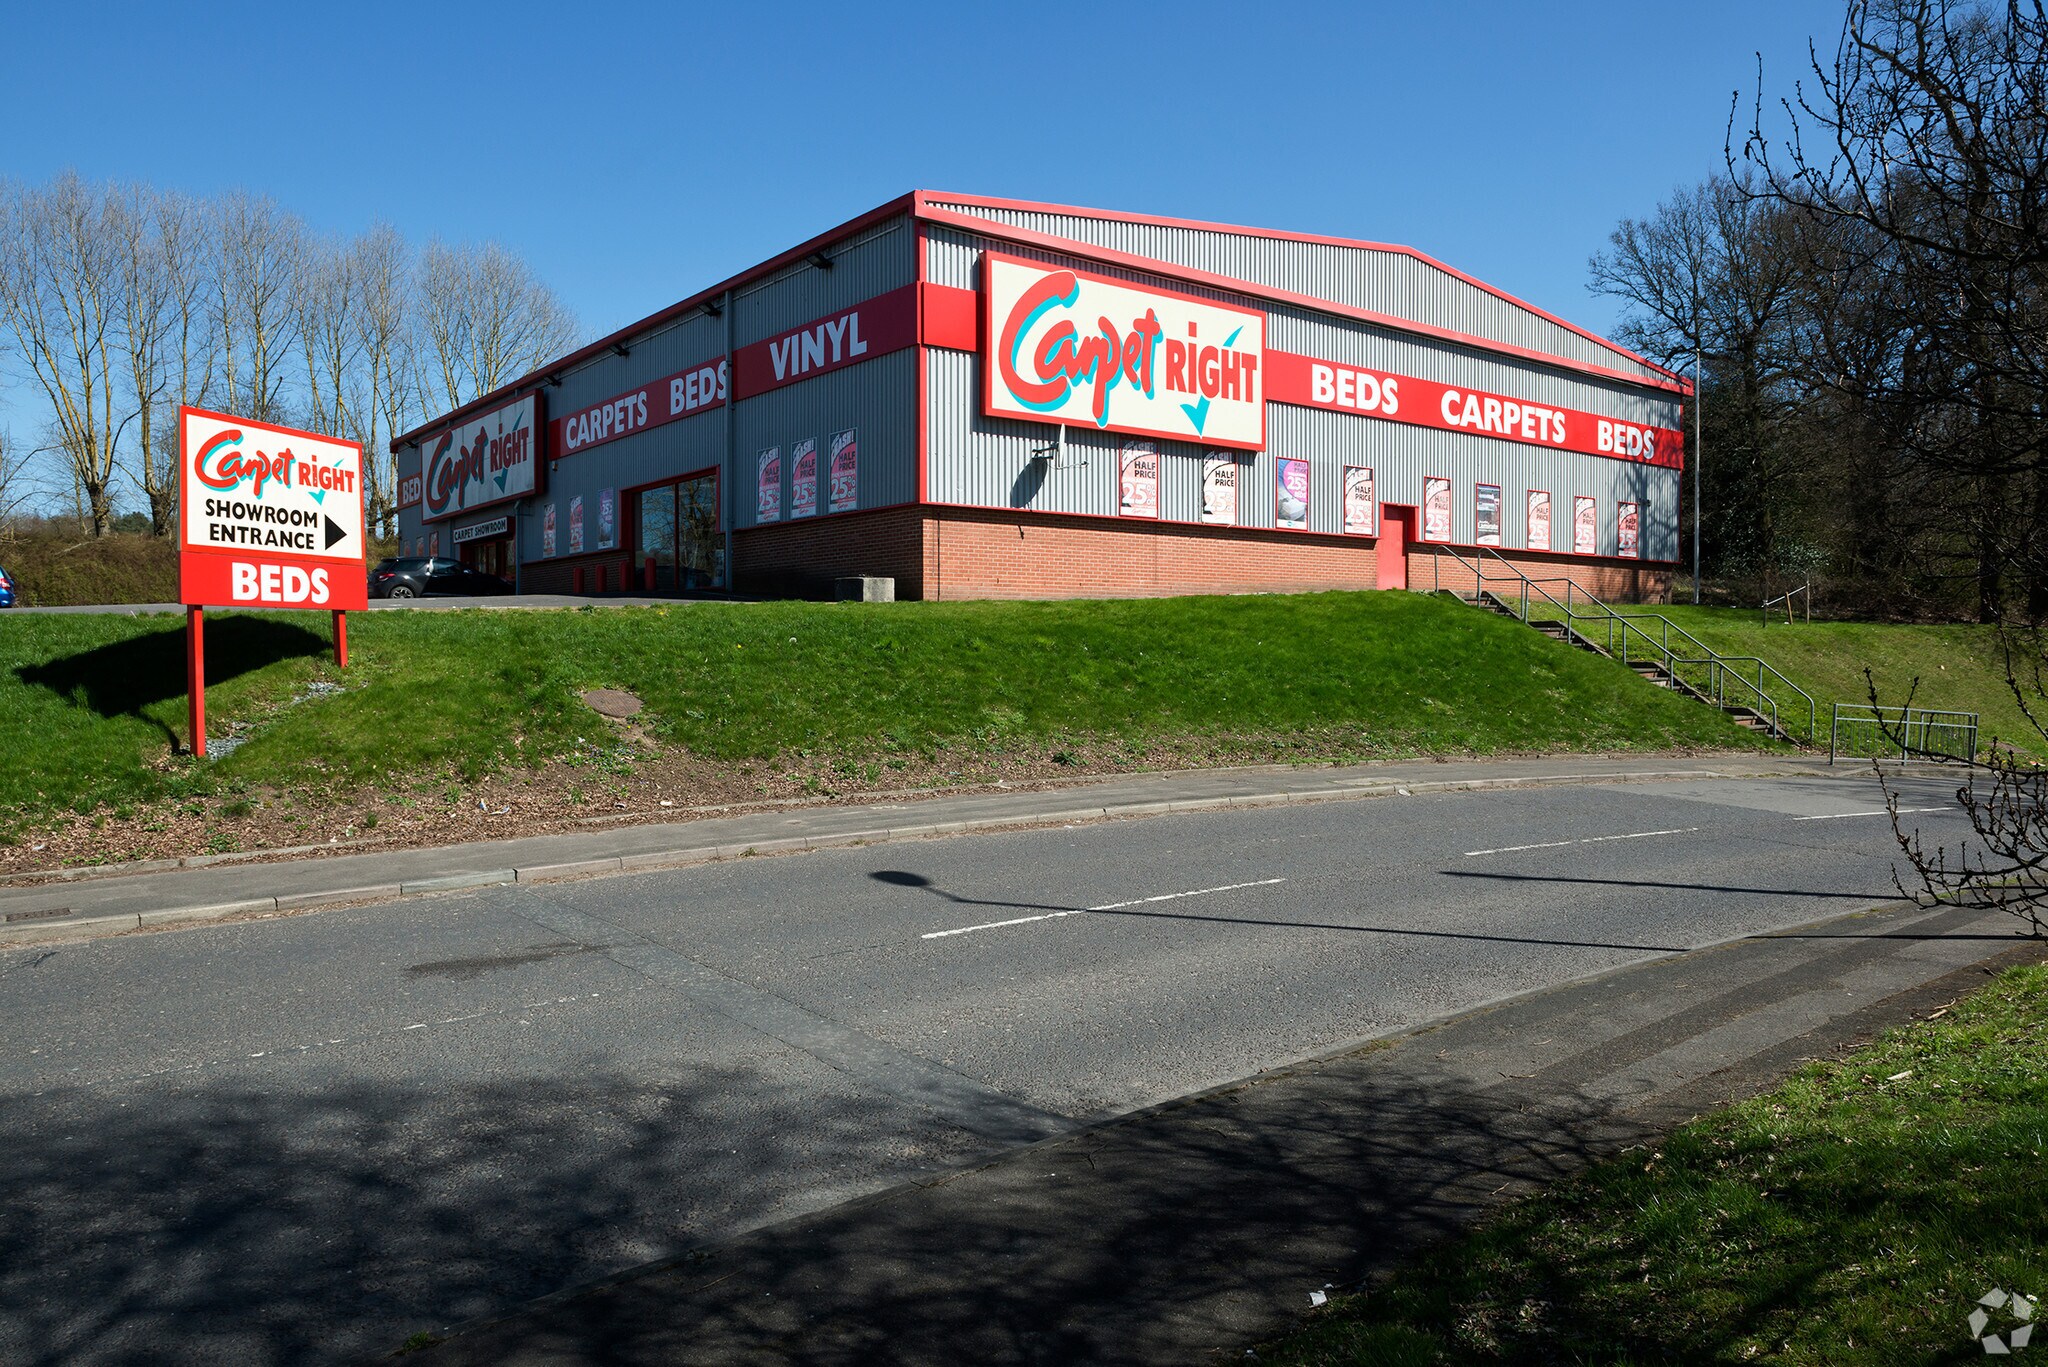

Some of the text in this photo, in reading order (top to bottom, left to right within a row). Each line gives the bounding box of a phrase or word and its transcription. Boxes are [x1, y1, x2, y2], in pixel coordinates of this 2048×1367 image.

[769, 311, 867, 382] VINYL
[999, 270, 1163, 428] Carpet
[565, 361, 727, 450] CARPETS BEDS
[1311, 363, 1655, 460] BEDS CARPETS BEDS
[838, 451, 855, 462] HALF
[194, 429, 296, 499] Carpet
[800, 459, 815, 469] HALF
[838, 460, 855, 471] PRICE
[1134, 461, 1156, 470] HALF
[426, 428, 489, 515] Carpet
[765, 466, 779, 477] HALF
[800, 468, 815, 478] PRICE
[1134, 470, 1156, 479] PRICE
[1215, 471, 1234, 479] HALF
[764, 475, 779, 485] PRICE
[1215, 479, 1234, 487] PRICE
[1355, 486, 1371, 494] HALF
[205, 498, 318, 528] SHOWROOM
[454, 519, 507, 541] CARPET SHOWROOM
[209, 523, 315, 550] ENTRANCE
[231, 562, 330, 605] BEDS
